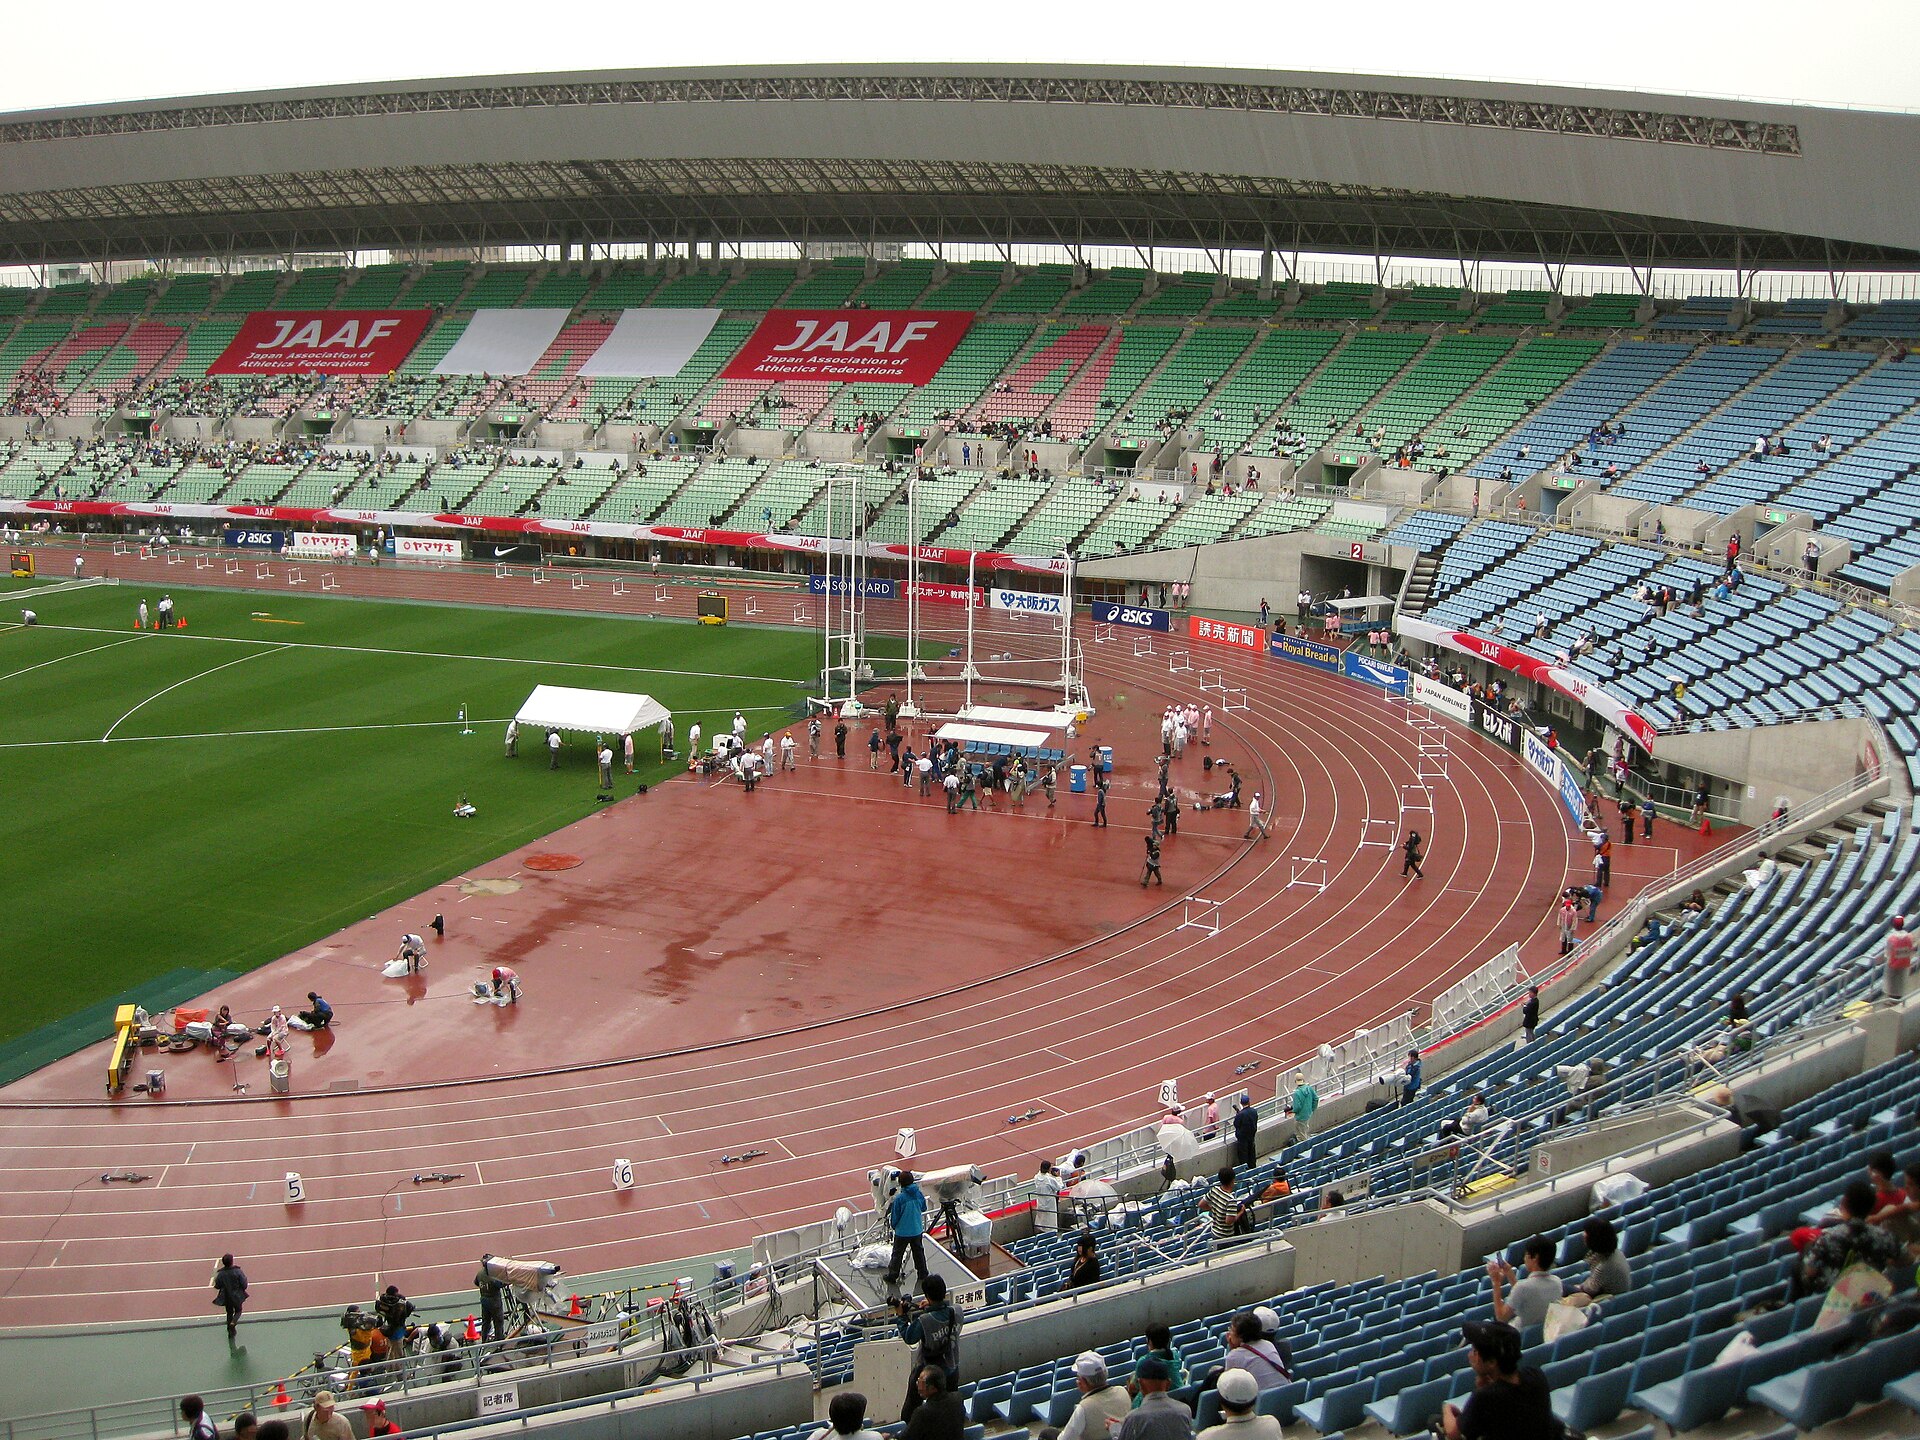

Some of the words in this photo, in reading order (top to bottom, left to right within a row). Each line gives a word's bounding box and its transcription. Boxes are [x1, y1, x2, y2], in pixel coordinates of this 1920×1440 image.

[256, 319, 401, 349] JAAF
[772, 319, 938, 353] JAAF
[246, 351, 283, 360] Japan
[287, 351, 357, 360] Association
[359, 351, 375, 359] of
[761, 354, 804, 364] Japan
[807, 355, 887, 365] Association
[892, 357, 909, 366] of
[238, 360, 294, 368] Athletics
[297, 360, 371, 368] Federations
[754, 364, 817, 374] Athletics
[820, 365, 904, 376] Federations
[53, 502, 72, 511] JAAF
[154, 505, 173, 513] JAAF
[255, 508, 275, 516] JAAF
[358, 512, 377, 520] JAAF
[463, 517, 483, 526] JAAF
[570, 523, 591, 532] JAAF
[681, 530, 704, 539] JAAF
[247, 532, 272, 544] asics
[799, 538, 821, 548] JAAF
[920, 548, 944, 559] JAAF
[1352, 544, 1361, 558] 2
[814, 579, 855, 592] SASON
[858, 582, 890, 594] CARD
[1015, 594, 1061, 614] 大阪ガス
[1121, 608, 1153, 626] asics
[1198, 620, 1254, 647] 読売新聞
[1282, 641, 1304, 656] Royal
[1305, 647, 1329, 663] Bread
[1480, 641, 1500, 659] JAAF
[1358, 656, 1377, 668] POCARI
[1377, 661, 1394, 674] SWEAT
[1572, 679, 1588, 698] JAAF
[1424, 687, 1442, 700] JAPAN
[1442, 695, 1468, 712] AIRLINES
[1162, 1085, 1170, 1102] 8
[899, 1133, 906, 1150] 7
[908, 1134, 915, 1152] 7
[621, 1165, 632, 1184] 6
[288, 1179, 301, 1199] 5
[955, 1289, 984, 1305] 記者席
[483, 1391, 514, 1408] 記者席
